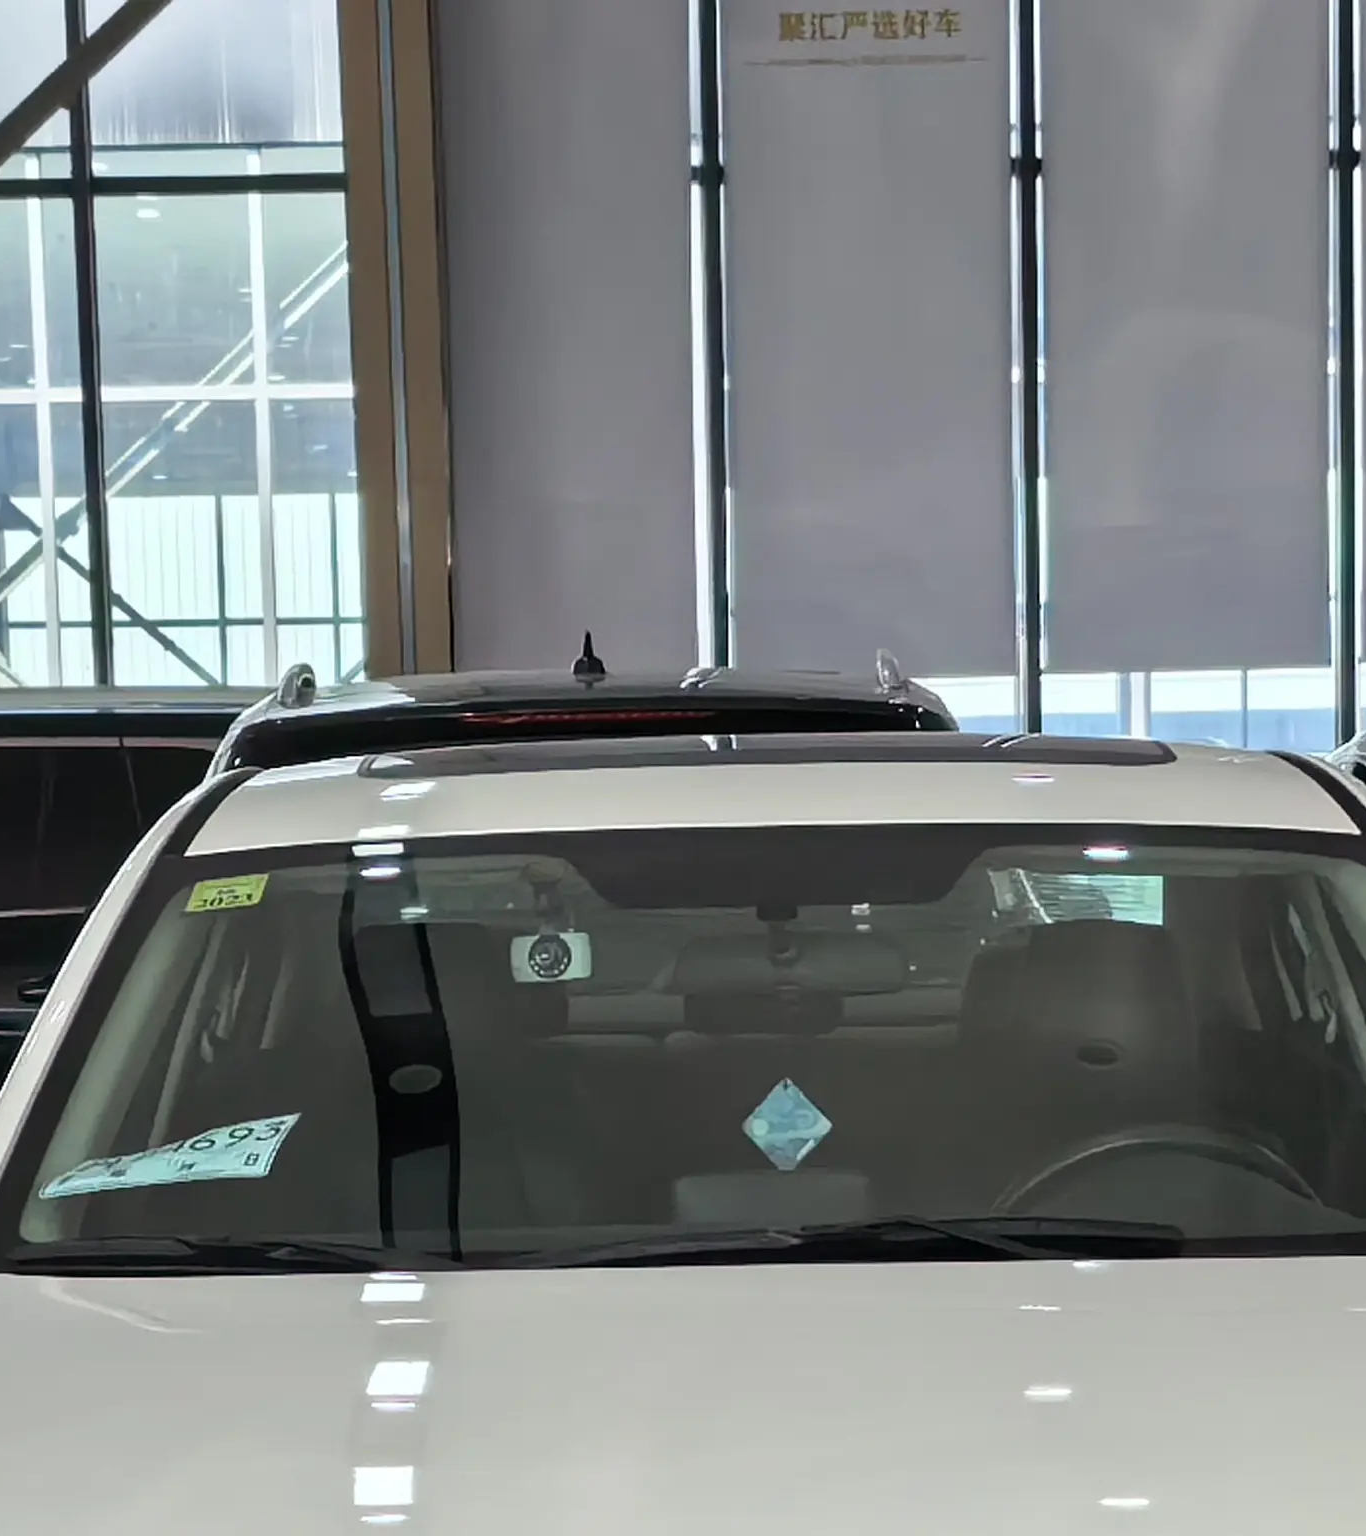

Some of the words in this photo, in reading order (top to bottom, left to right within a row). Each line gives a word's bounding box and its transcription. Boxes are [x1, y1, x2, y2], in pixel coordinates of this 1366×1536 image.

[778, 9, 963, 42] 聚汇严选好车
